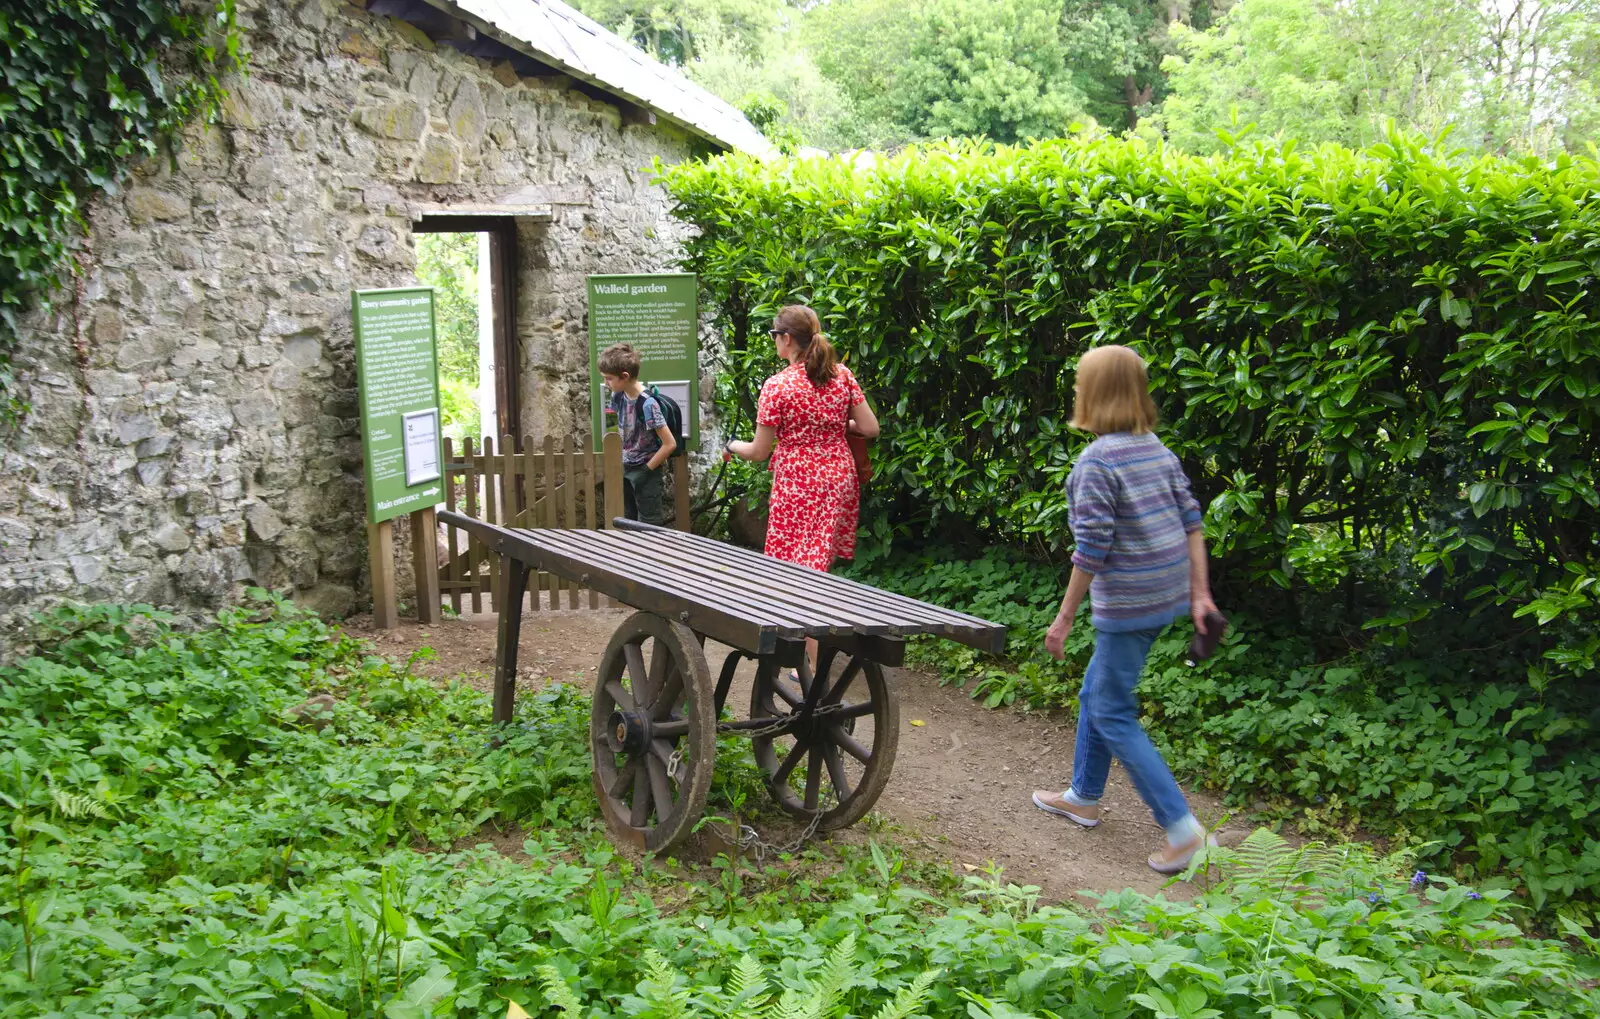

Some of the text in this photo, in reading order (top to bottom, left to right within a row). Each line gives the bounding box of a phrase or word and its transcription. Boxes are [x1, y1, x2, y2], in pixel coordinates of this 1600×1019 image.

[594, 284, 667, 295] Walled garden
[361, 296, 430, 310] Bovey community garden
[377, 494, 420, 511] Main entrance
